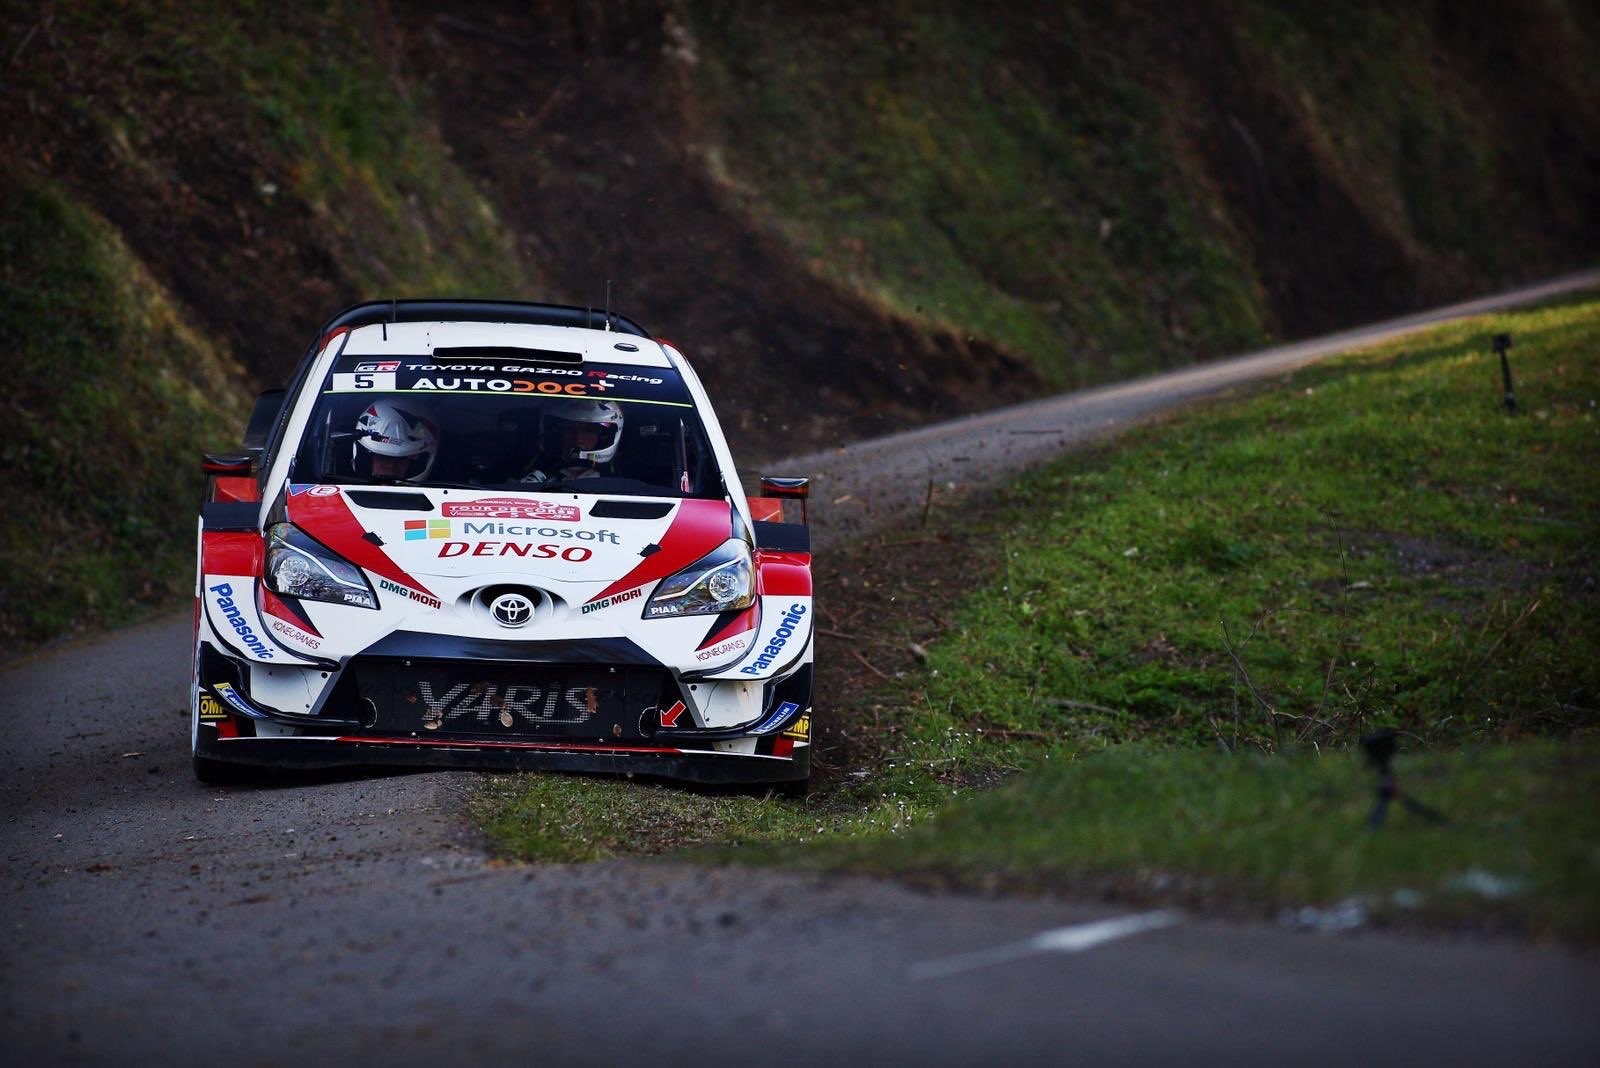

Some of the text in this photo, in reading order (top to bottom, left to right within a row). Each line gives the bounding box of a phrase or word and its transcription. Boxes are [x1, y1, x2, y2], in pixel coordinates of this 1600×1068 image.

[354, 374, 374, 389] 5
[405, 364, 664, 385] TOYOTA GAZOO Racing
[524, 507, 577, 515] CORSE
[463, 522, 621, 545] Microsoft
[437, 541, 593, 562] DENSO
[343, 593, 371, 605] PIAA
[379, 580, 442, 609] DMG MORI
[581, 588, 642, 614] DMG MORI
[209, 583, 274, 660] Panasonic
[650, 605, 678, 615] PIAA
[272, 620, 321, 650] KONECRANES
[740, 603, 807, 676] Panasonic
[695, 639, 745, 662] KONECRANES
[417, 680, 598, 724] YARIS
